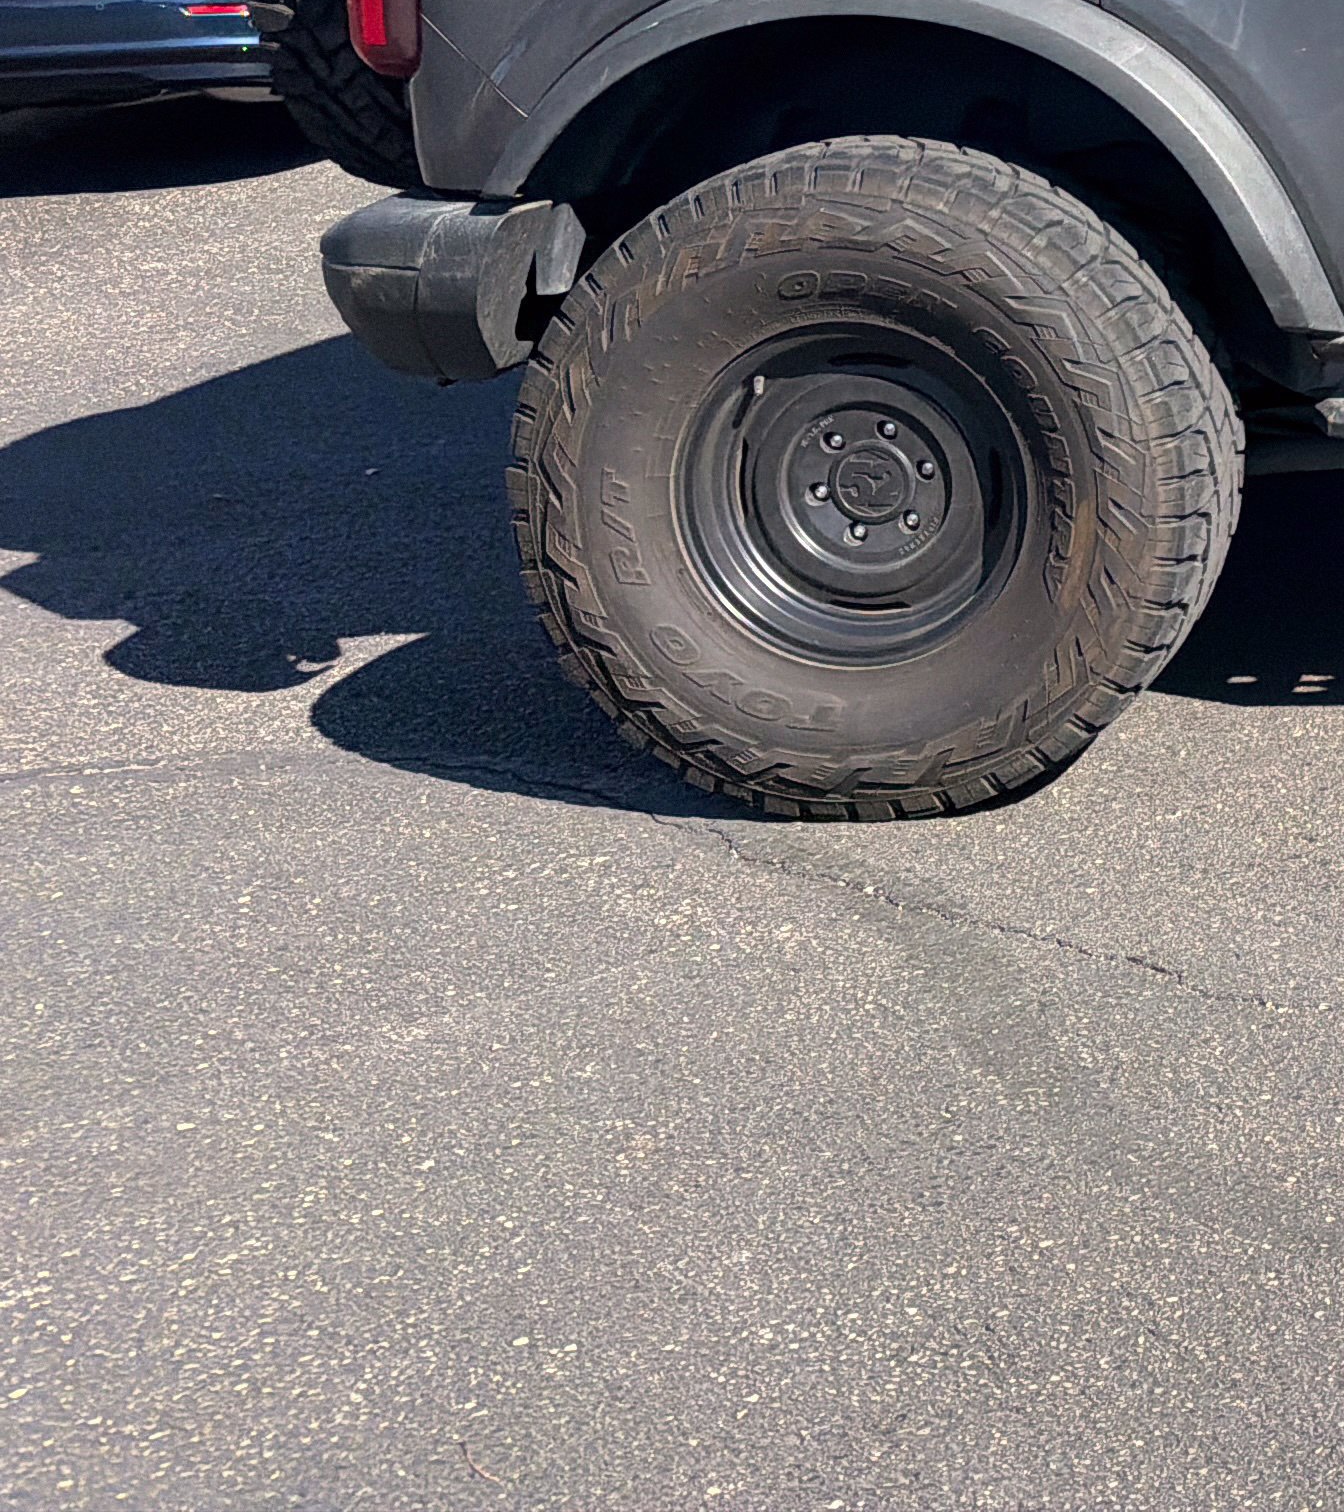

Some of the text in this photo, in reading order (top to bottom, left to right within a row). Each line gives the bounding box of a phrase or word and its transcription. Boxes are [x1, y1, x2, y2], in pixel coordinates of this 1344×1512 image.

[777, 270, 958, 312] OPEN
[601, 466, 651, 586] R/T
[650, 623, 846, 732] TOYO
